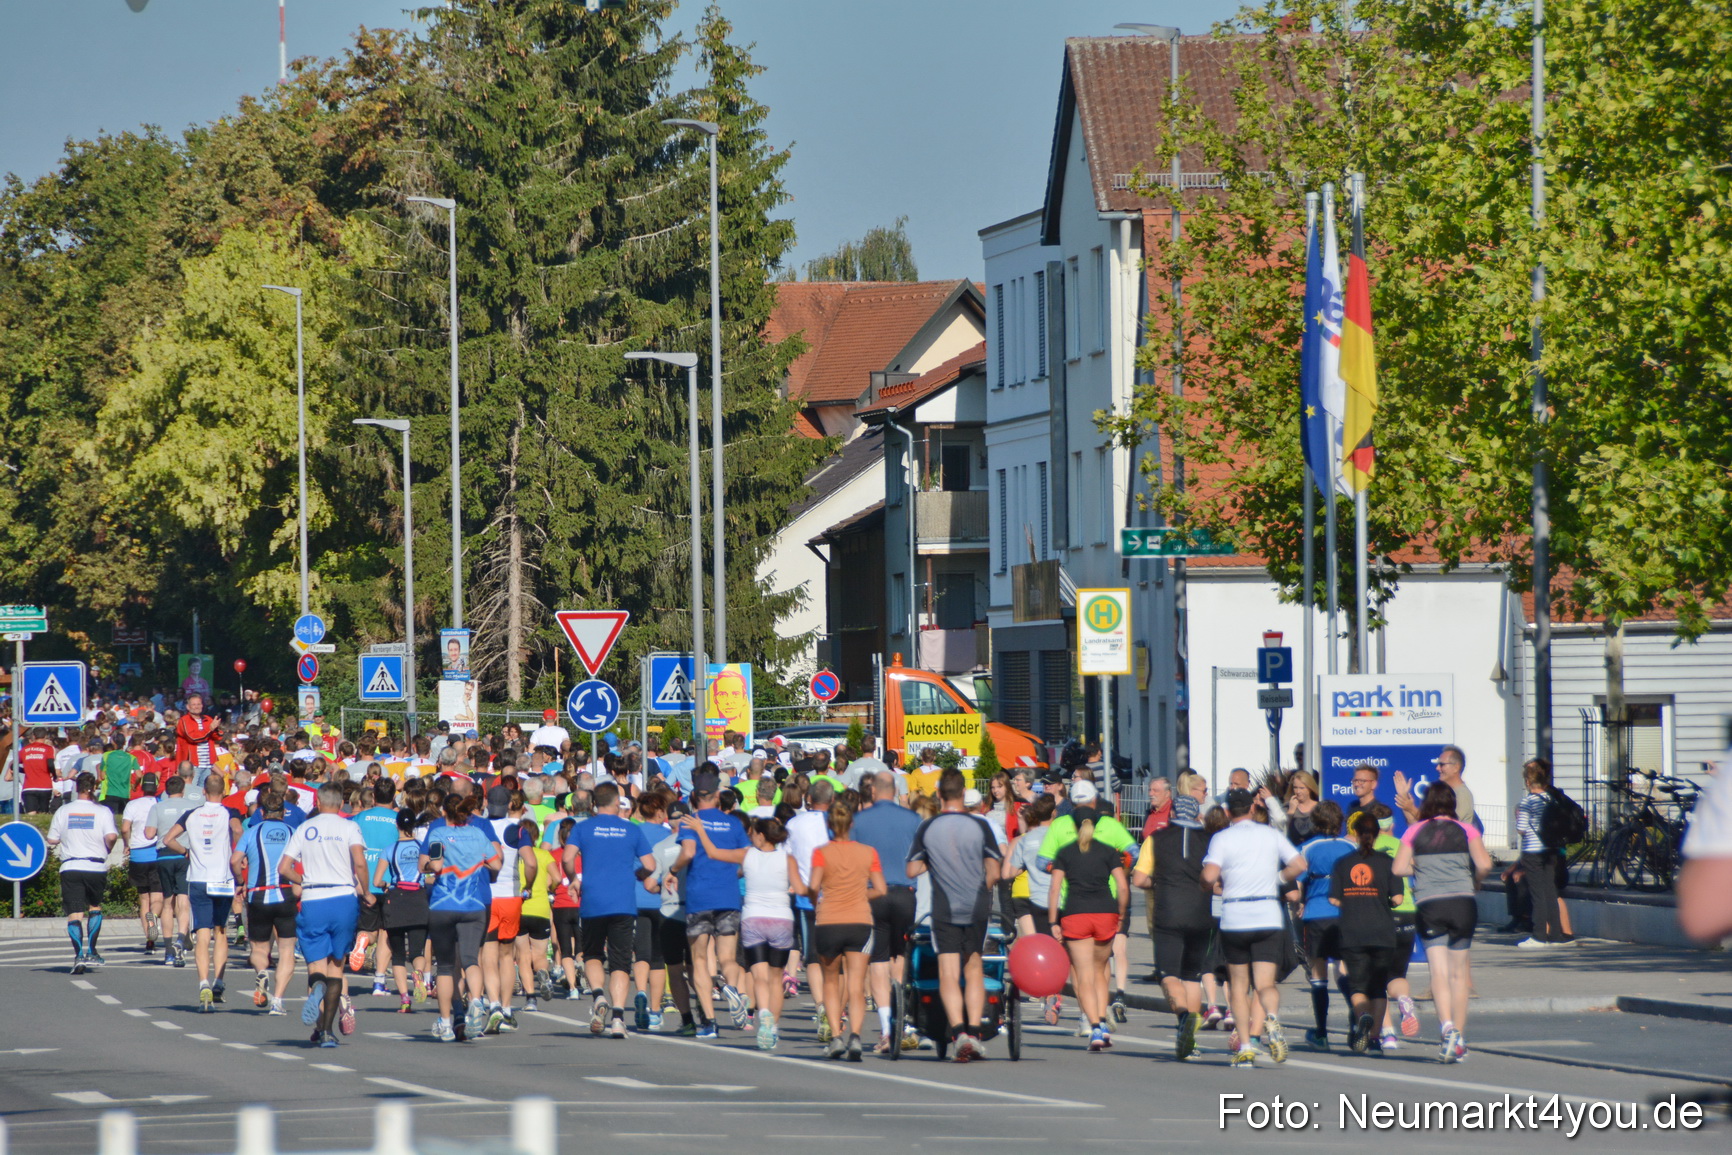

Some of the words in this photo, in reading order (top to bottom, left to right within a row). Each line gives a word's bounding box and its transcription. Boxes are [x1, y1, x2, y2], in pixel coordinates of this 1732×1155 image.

[1094, 604, 1113, 625] H
[1265, 652, 1284, 679] P
[1220, 669, 1258, 678] Schwarzach
[1260, 694, 1290, 704] Reisebus
[1332, 685, 1393, 717] park
[1400, 684, 1442, 708] inn
[1407, 708, 1442, 721] Radisson
[906, 719, 979, 735] Autoschilder
[1332, 727, 1356, 735] hotel
[1366, 726, 1382, 735] bar
[1392, 726, 1443, 735] restaurant
[1332, 756, 1387, 767] Reception
[370, 815, 397, 825] PFLEIDERE
